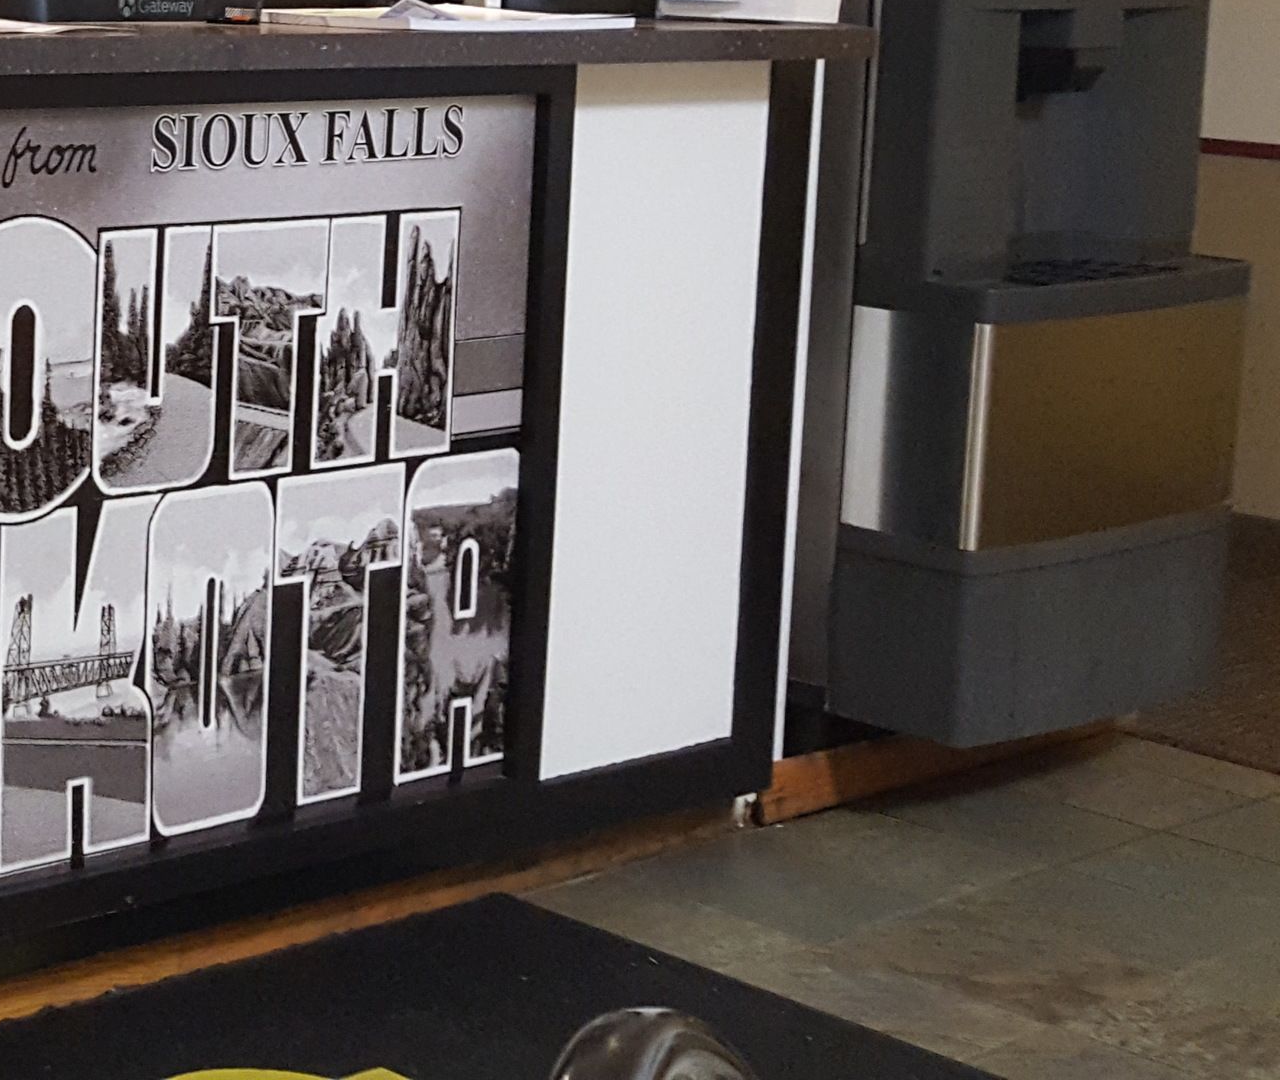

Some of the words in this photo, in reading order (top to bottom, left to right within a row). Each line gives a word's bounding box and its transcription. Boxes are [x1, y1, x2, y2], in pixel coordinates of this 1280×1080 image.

[1, 127, 97, 188] from
[151, 112, 310, 172] SIOUX
[320, 104, 464, 165] FALLS
